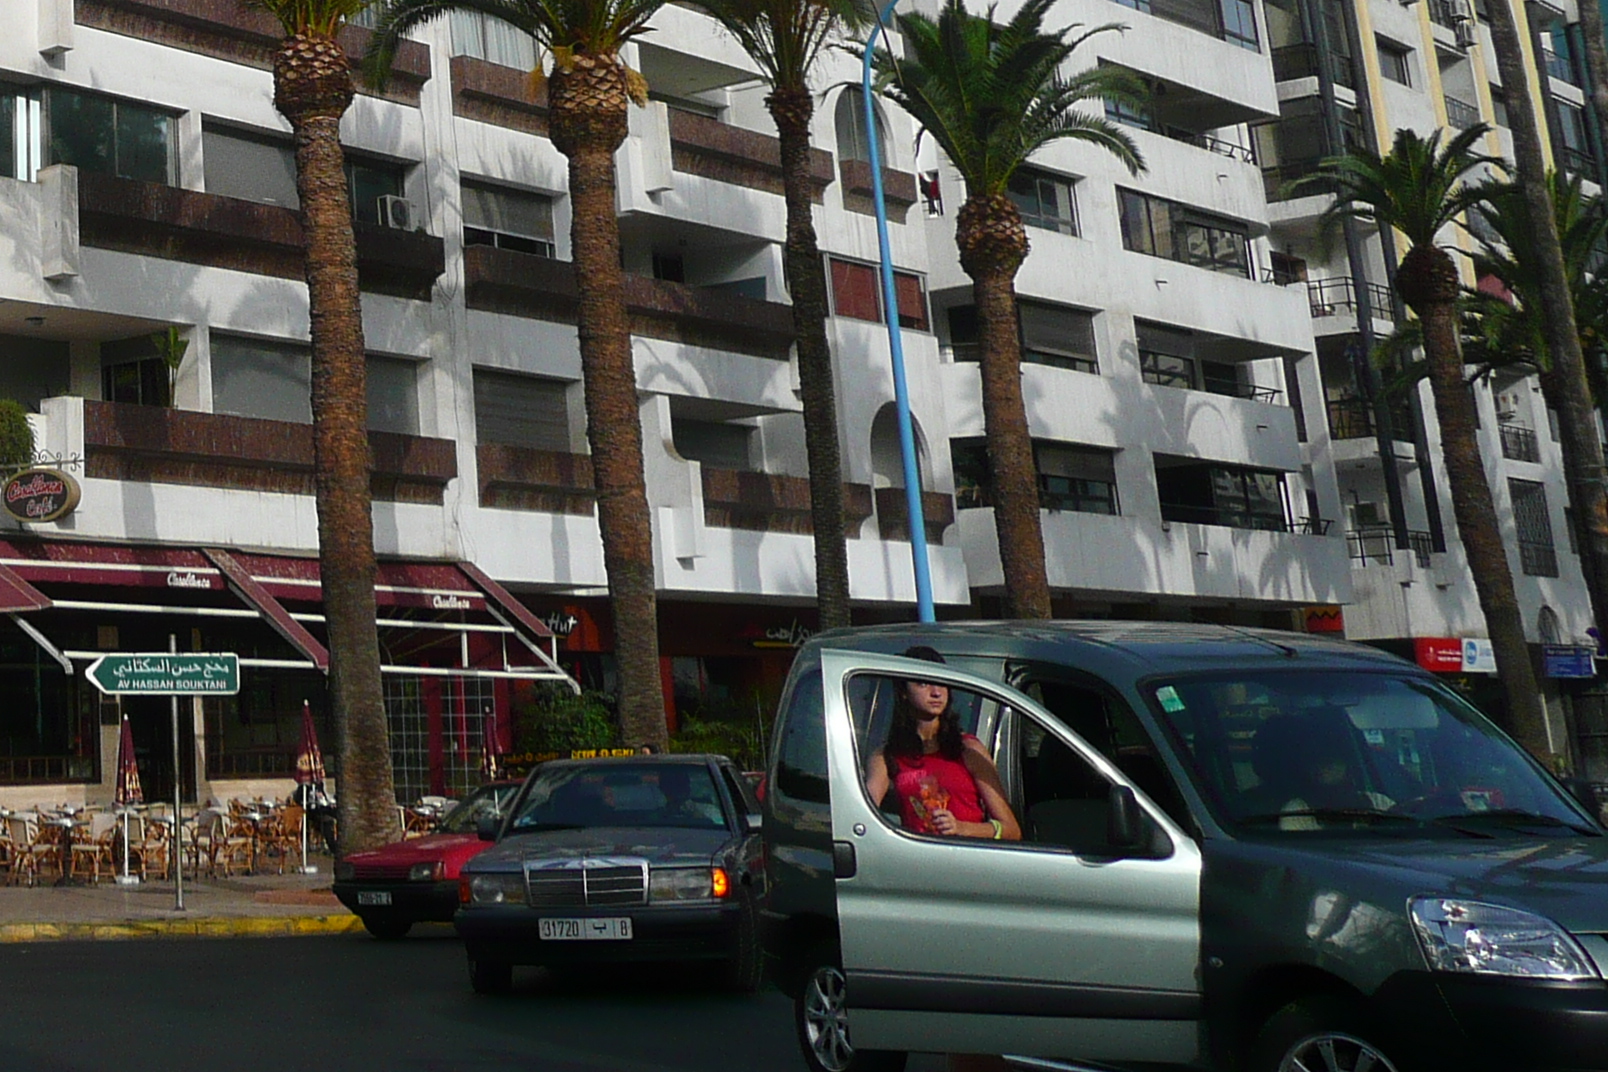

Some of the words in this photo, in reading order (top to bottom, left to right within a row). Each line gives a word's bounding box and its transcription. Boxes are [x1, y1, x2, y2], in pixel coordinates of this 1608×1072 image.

[172, 662, 201, 676] حسن
[117, 679, 130, 689] AV
[132, 679, 173, 689] HASSAN
[176, 679, 226, 689] SOUKTANI
[544, 921, 579, 937] 31720
[620, 920, 628, 936] 8
